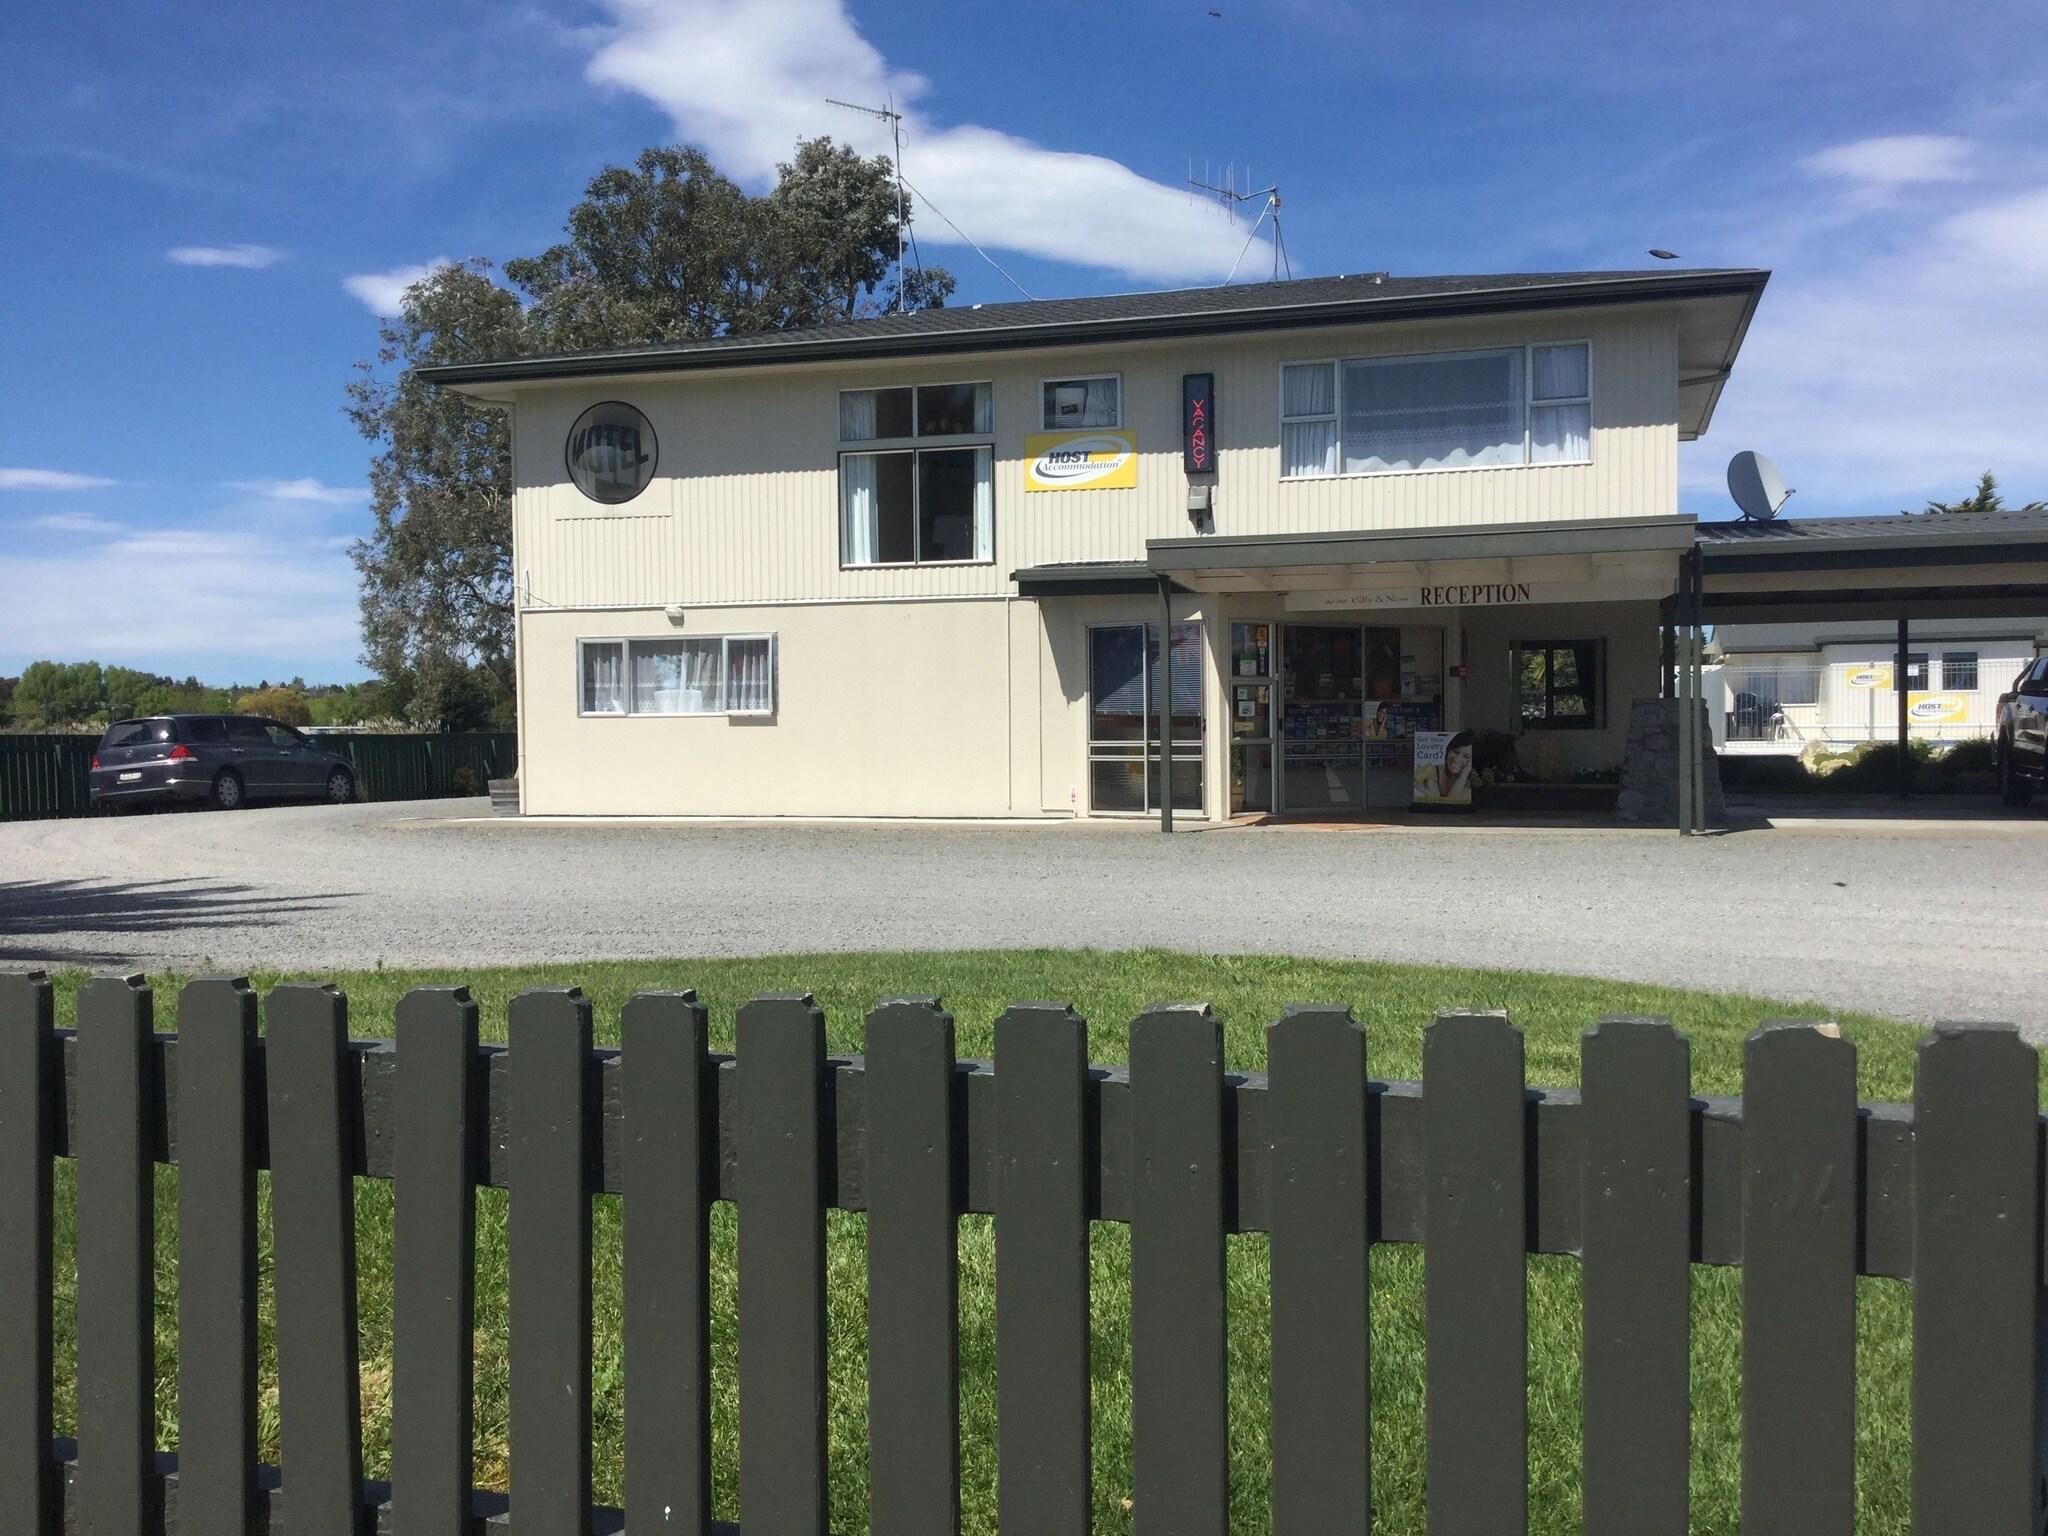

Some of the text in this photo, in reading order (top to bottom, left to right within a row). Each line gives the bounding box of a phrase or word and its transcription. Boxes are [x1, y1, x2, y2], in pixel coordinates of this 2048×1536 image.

[1193, 399, 1205, 469] VACANCY
[572, 424, 649, 474] MOTEL
[1048, 450, 1092, 464] HOST
[1042, 460, 1119, 472] Accommodation
[1420, 583, 1530, 605] RECEPTION
[1416, 751, 1444, 760] Card?
